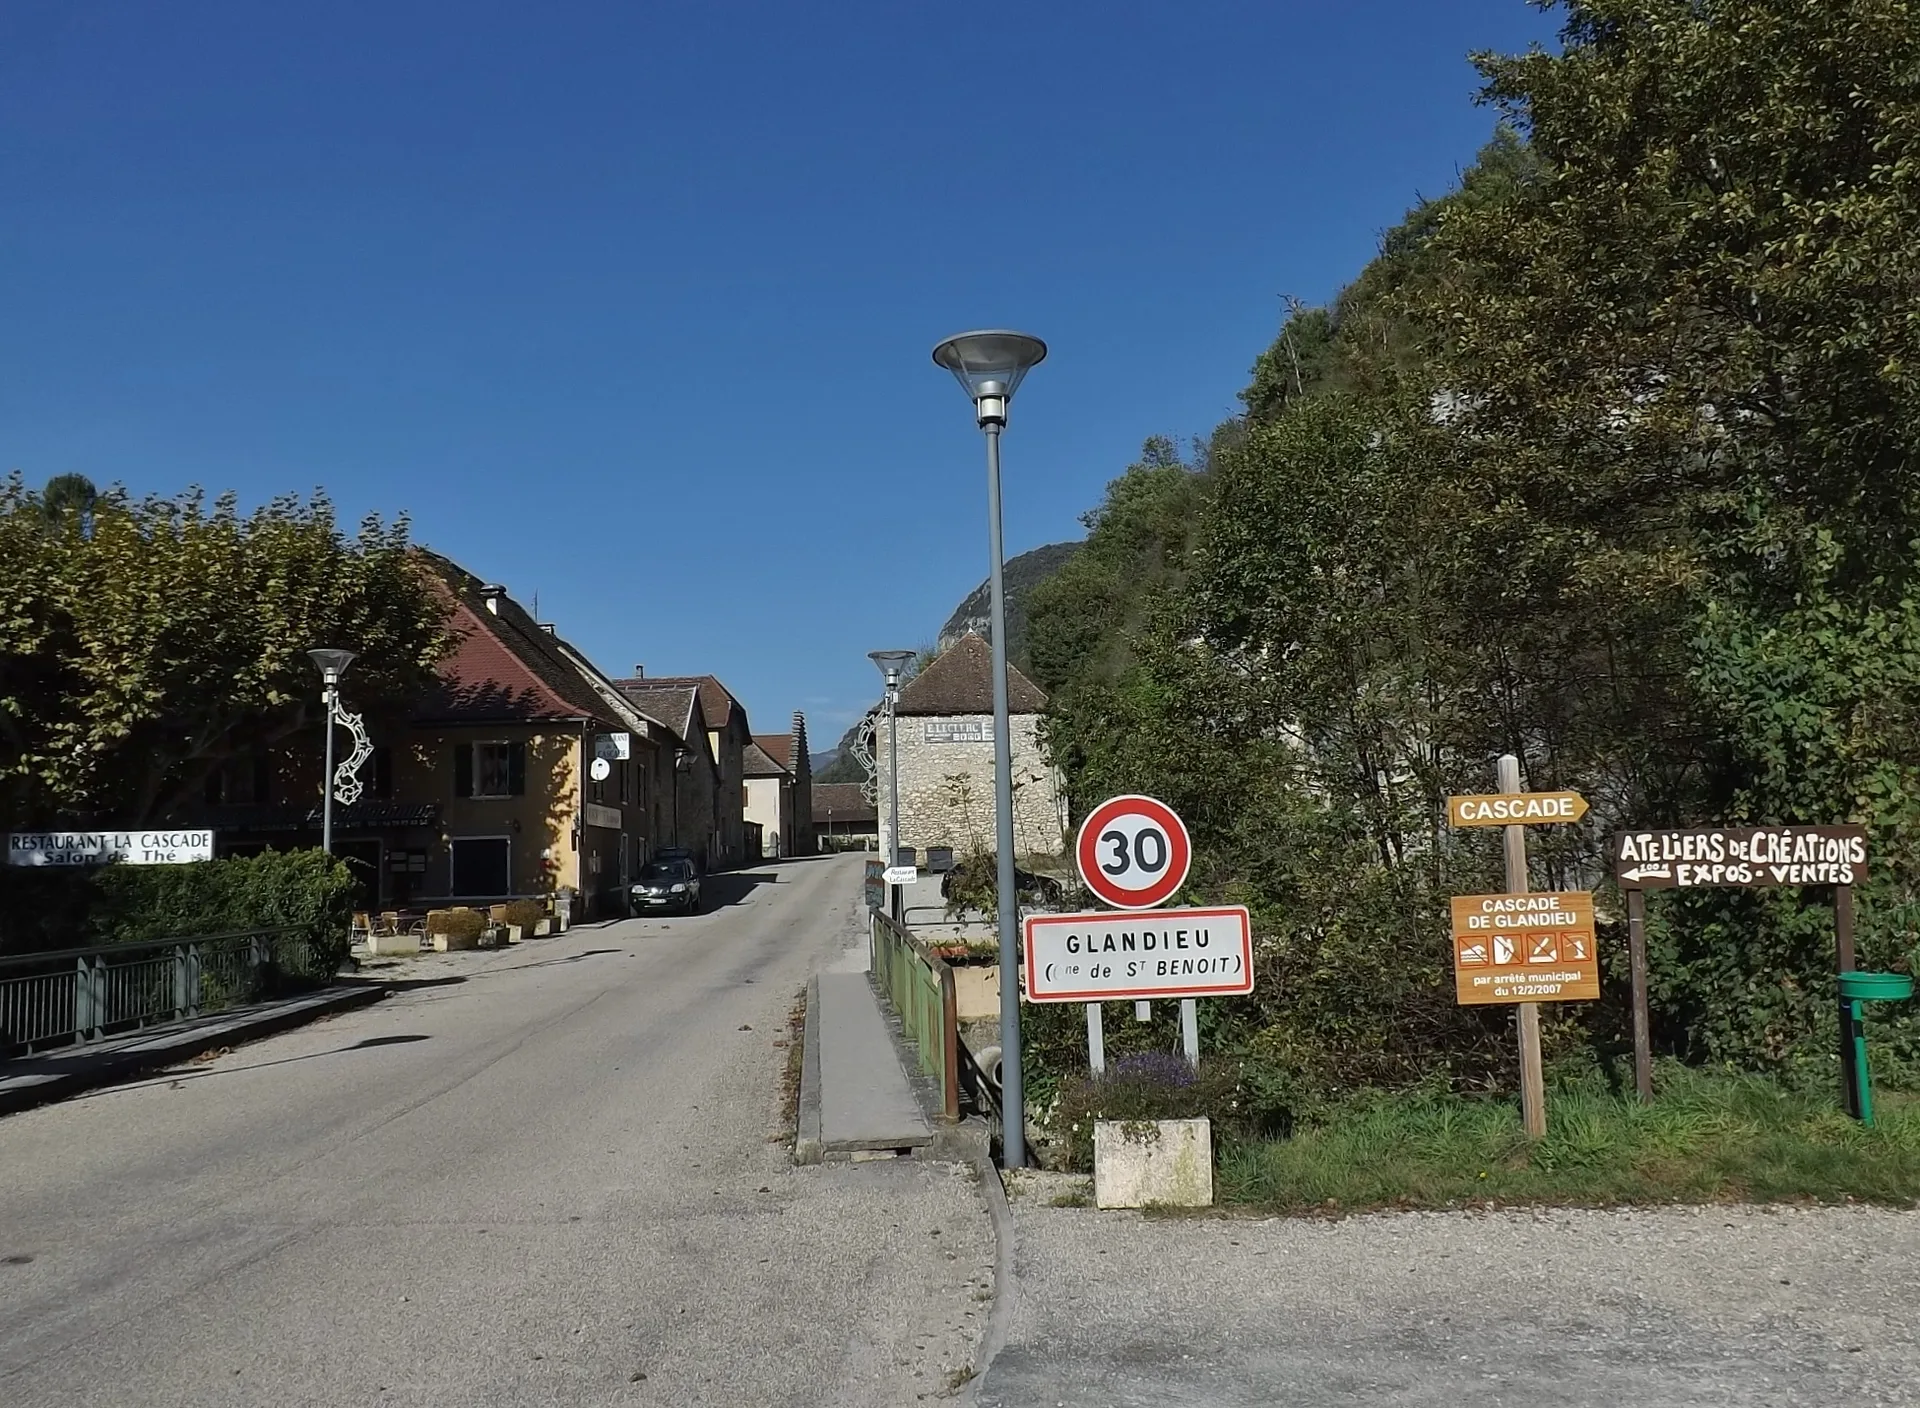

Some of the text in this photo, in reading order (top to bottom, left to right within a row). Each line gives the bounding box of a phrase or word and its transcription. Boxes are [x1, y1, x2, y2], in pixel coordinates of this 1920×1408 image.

[1460, 797, 1575, 820] CASCADE
[11, 832, 209, 851] RESTAURANT LA CASCADE
[1101, 827, 1167, 876] 30
[1729, 839, 1750, 861] DE
[43, 851, 97, 864] Salon
[107, 851, 130, 863] de
[142, 850, 176, 862] Thé
[1676, 863, 1753, 886] EXPOS
[1769, 862, 1854, 884] VENTES
[1482, 897, 1560, 912] CASCADE
[1468, 912, 1577, 929] DE GLANDIEU
[1066, 929, 1209, 954] GLANDIEU
[1090, 963, 1111, 978] de
[1156, 954, 1241, 976] BENOIT)
[1473, 971, 1581, 987] par arrêté municipal
[1494, 984, 1562, 996] du 12/2/2007
